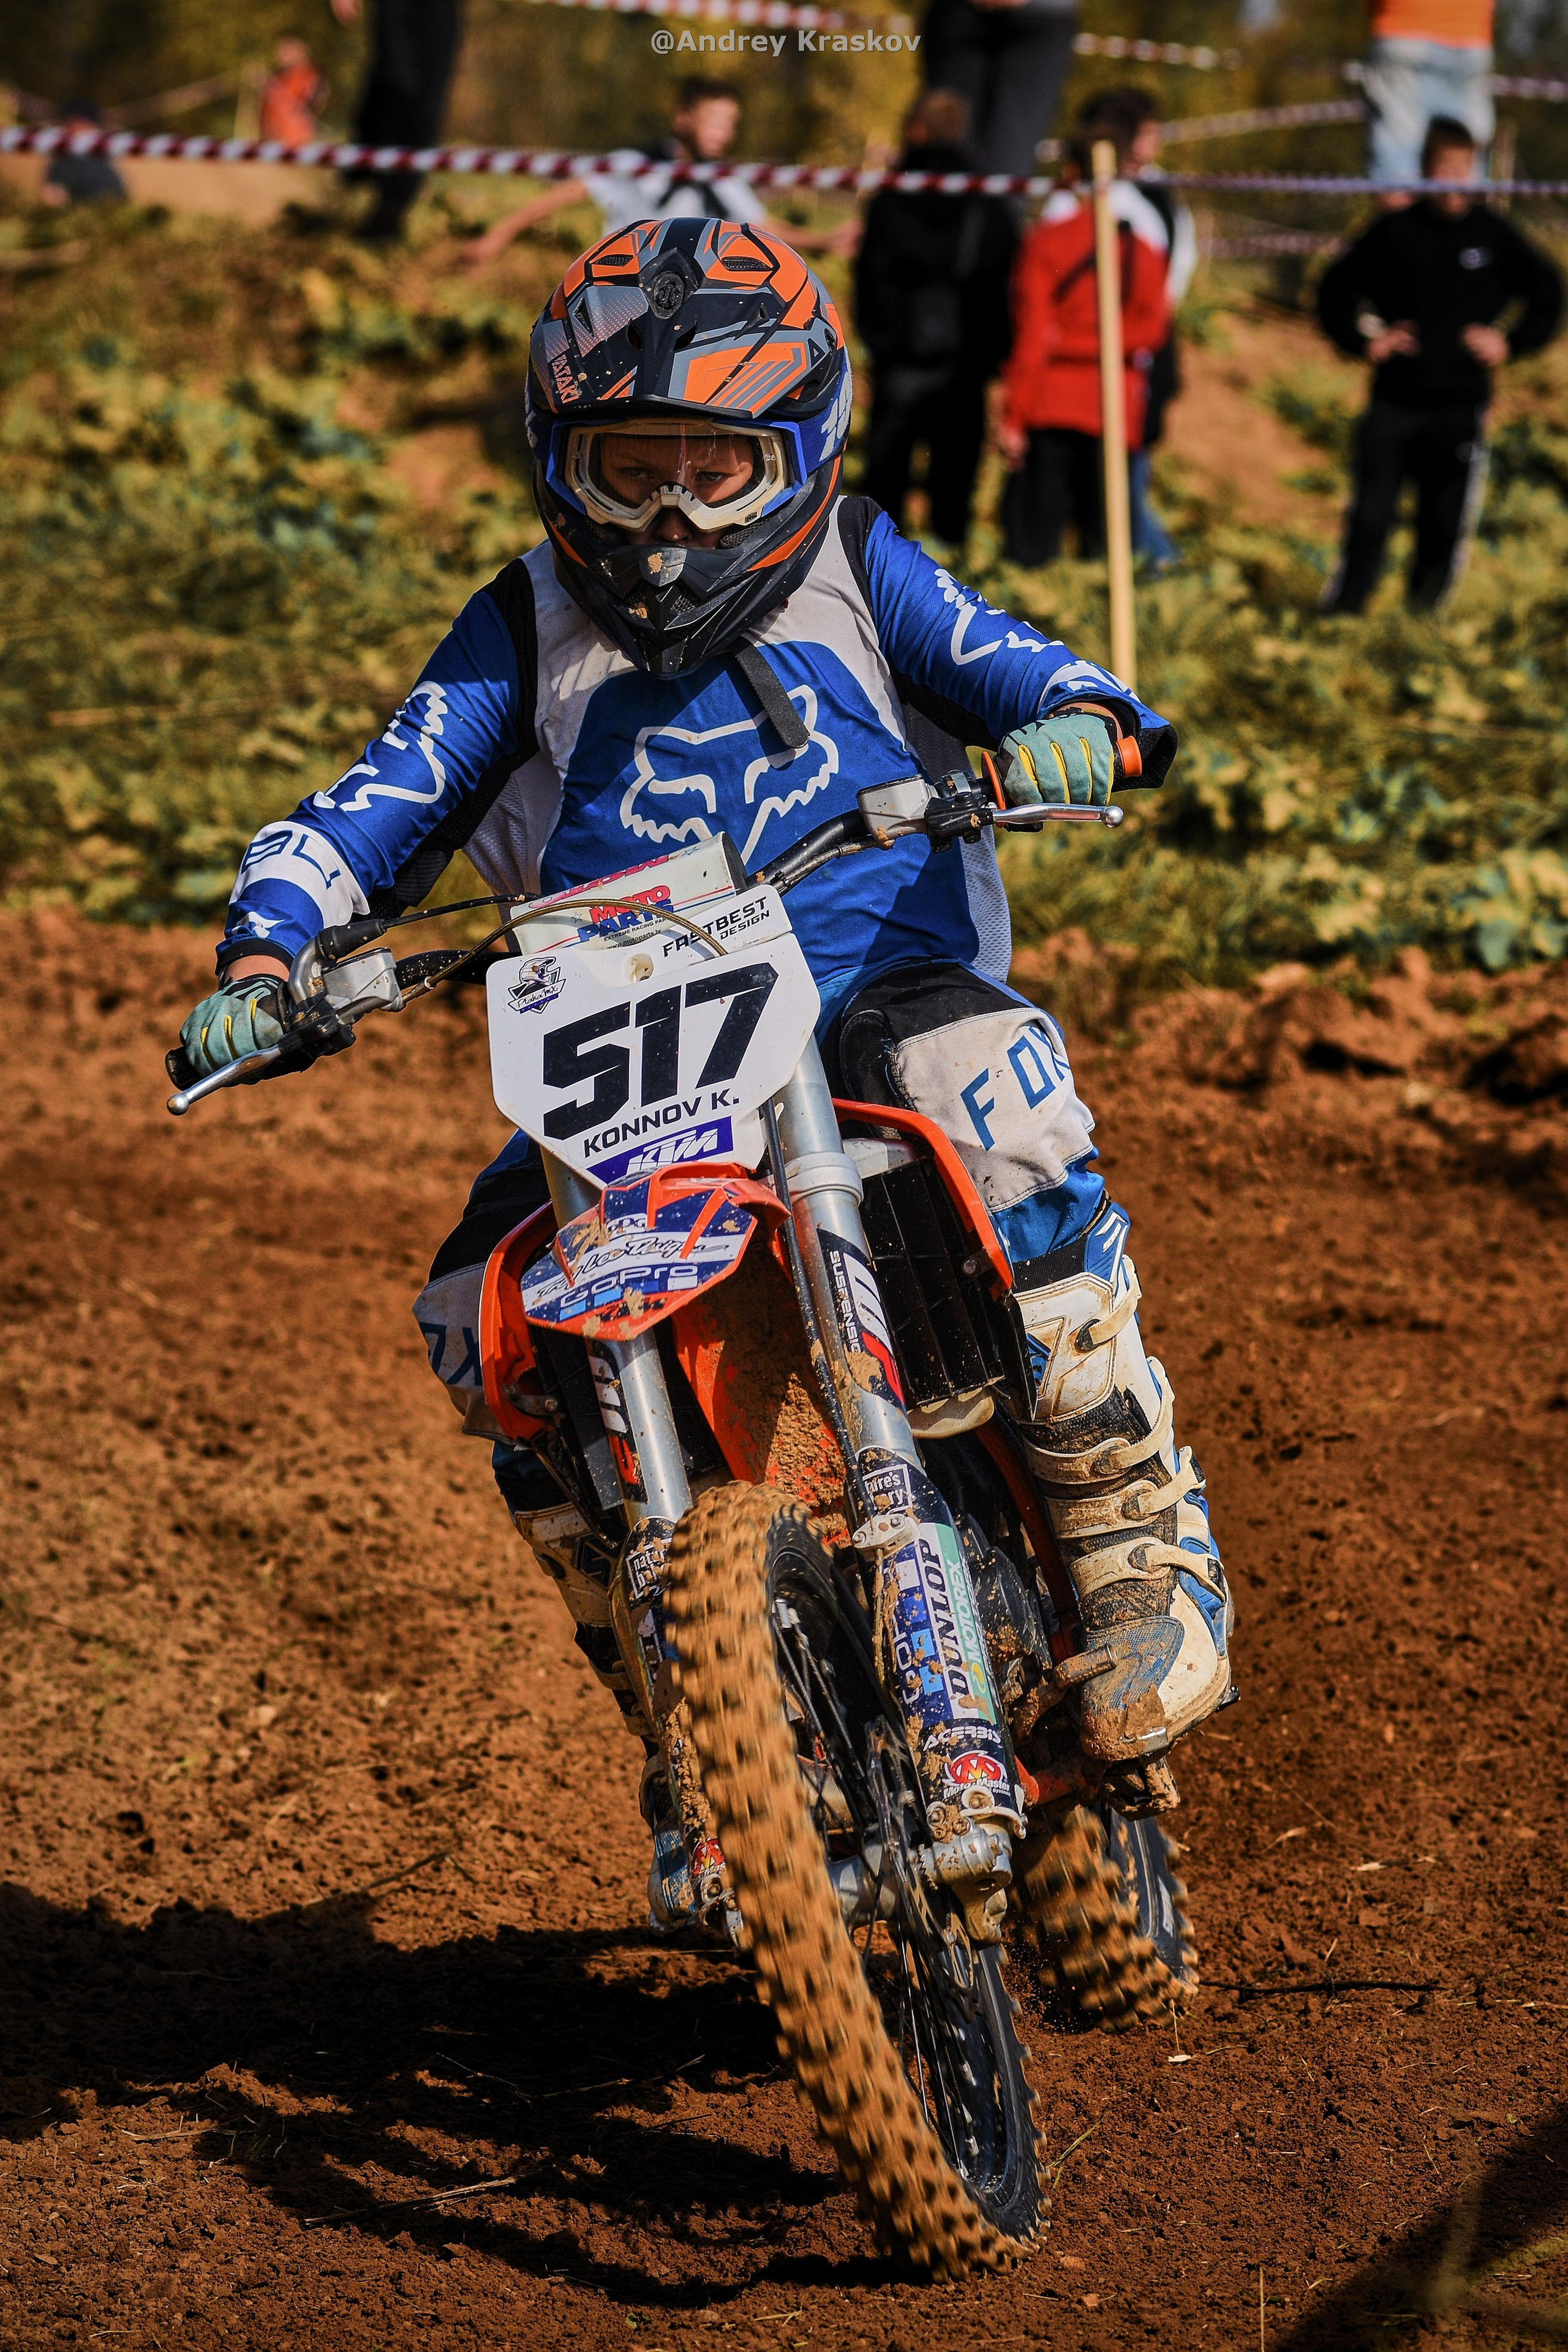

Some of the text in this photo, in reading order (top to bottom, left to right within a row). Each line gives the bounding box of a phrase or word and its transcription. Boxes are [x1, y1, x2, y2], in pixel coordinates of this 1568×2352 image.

[604, 927, 631, 941] EXTREME
[631, 922, 654, 932] RACING
[662, 895, 767, 958] FASTBEST
[720, 910, 770, 940] DESIGN
[543, 962, 779, 1140] 517
[584, 1088, 740, 1158] KONNOV K.
[626, 1128, 718, 1175] KTM
[829, 1250, 861, 1354] SUSPENSIO
[919, 1538, 970, 1696] DUNLOP
[946, 1558, 981, 1664] MOTOREX
[923, 1725, 1001, 1752] ACERBIS
